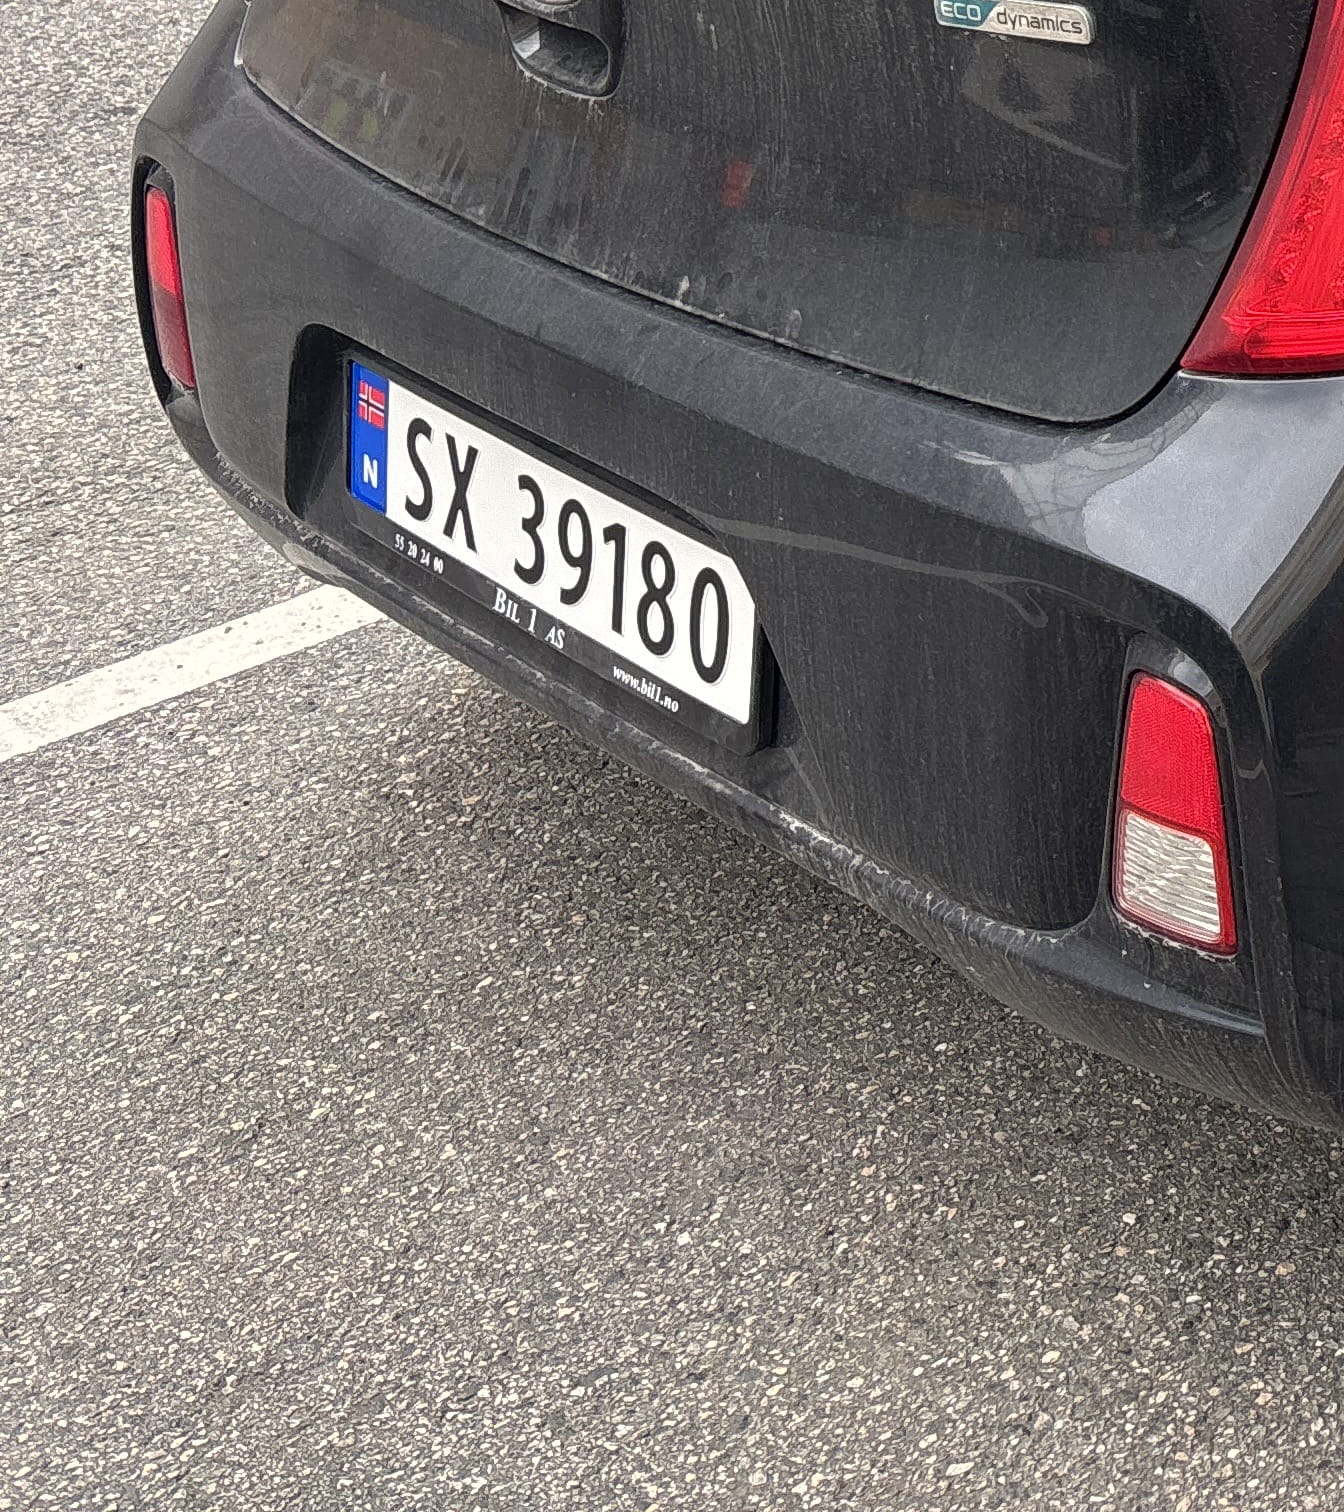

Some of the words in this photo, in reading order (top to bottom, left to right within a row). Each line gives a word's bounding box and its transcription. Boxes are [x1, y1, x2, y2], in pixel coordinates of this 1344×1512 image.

[940, 0, 982, 22] ECO
[996, 8, 1083, 34] dynamics
[363, 453, 378, 489] N
[404, 418, 479, 554] SX
[513, 474, 730, 685] 39180
[407, 540, 418, 559] 20
[420, 548, 431, 567] 24
[492, 587, 520, 623] BIL
[527, 608, 537, 634] 1
[545, 626, 566, 650] AS
[613, 665, 679, 713] www.bil1.no
